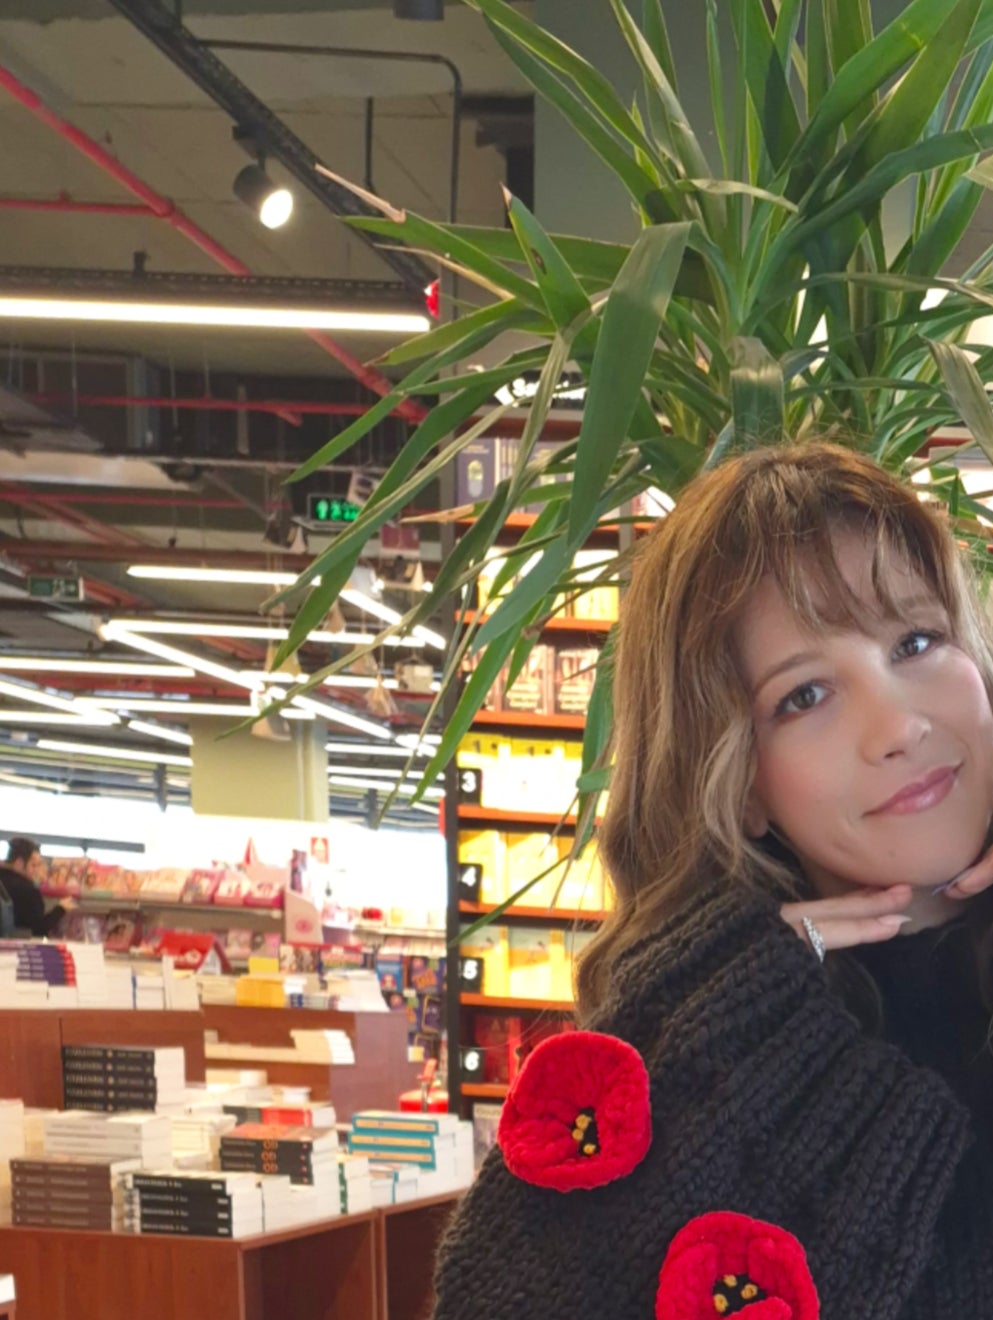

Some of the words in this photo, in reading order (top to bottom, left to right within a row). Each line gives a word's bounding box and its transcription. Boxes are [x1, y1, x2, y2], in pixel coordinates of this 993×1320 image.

[461, 771, 476, 793] 3
[461, 865, 477, 887] 4
[462, 960, 478, 980] 5
[463, 1050, 480, 1071] 6
